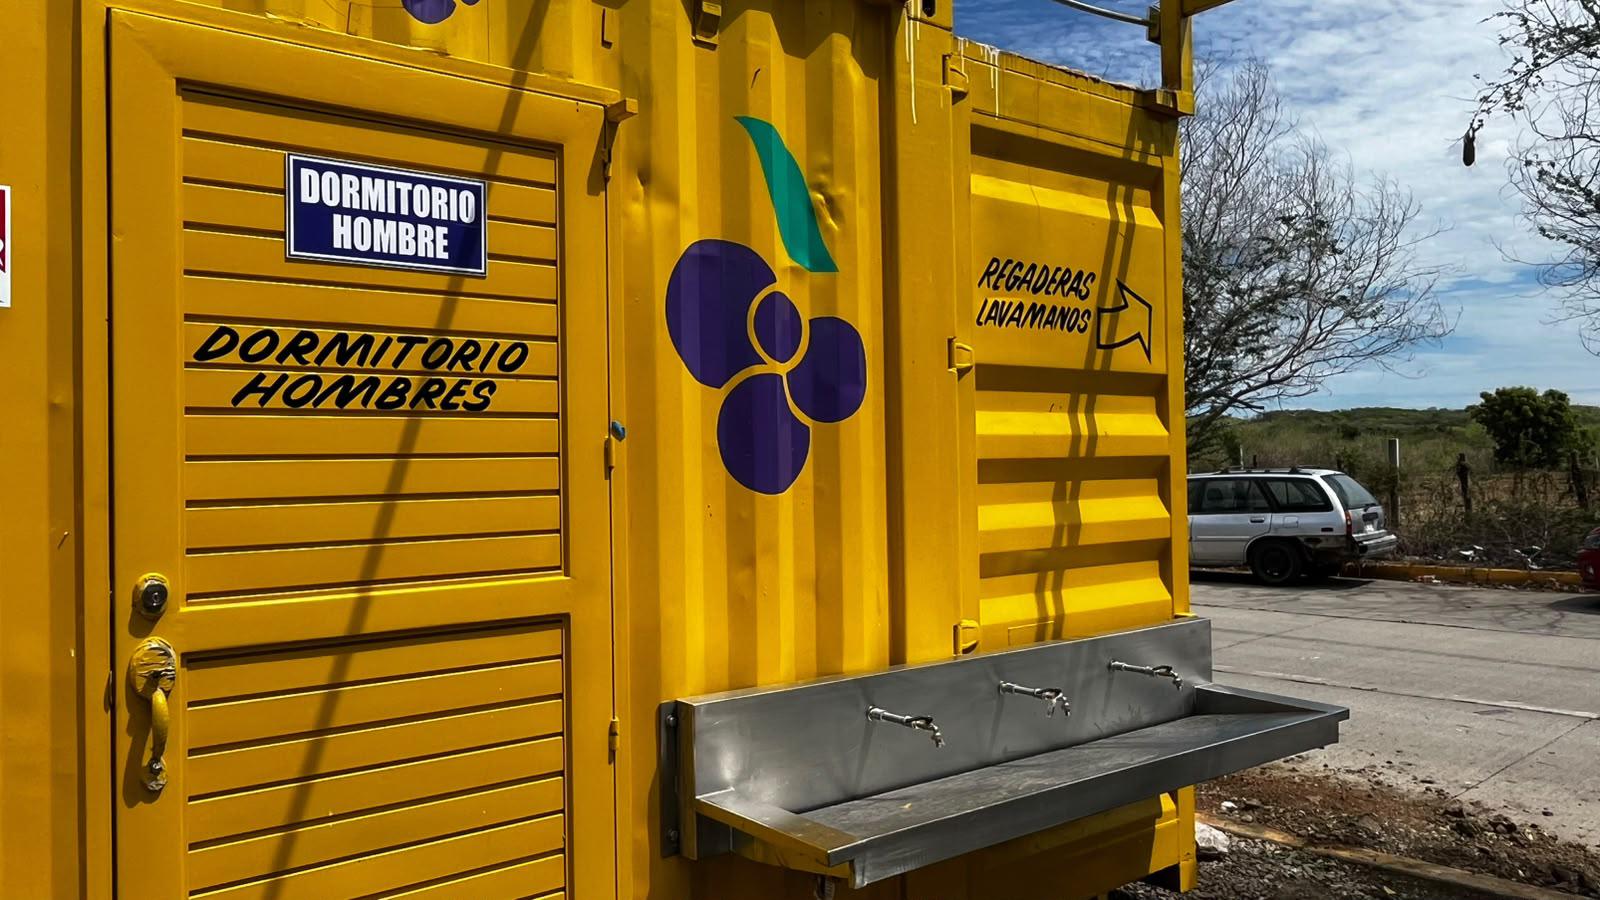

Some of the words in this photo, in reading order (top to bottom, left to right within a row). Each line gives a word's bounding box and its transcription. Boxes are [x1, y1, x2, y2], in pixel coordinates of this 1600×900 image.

[300, 167, 476, 223] DORMITORIO
[332, 212, 450, 260] HOMBRE
[978, 257, 1096, 301] REGADERAS
[976, 298, 1092, 334] LAVAMANOS
[193, 326, 529, 373] DORMITORIO
[231, 372, 497, 412] HOMBRES
